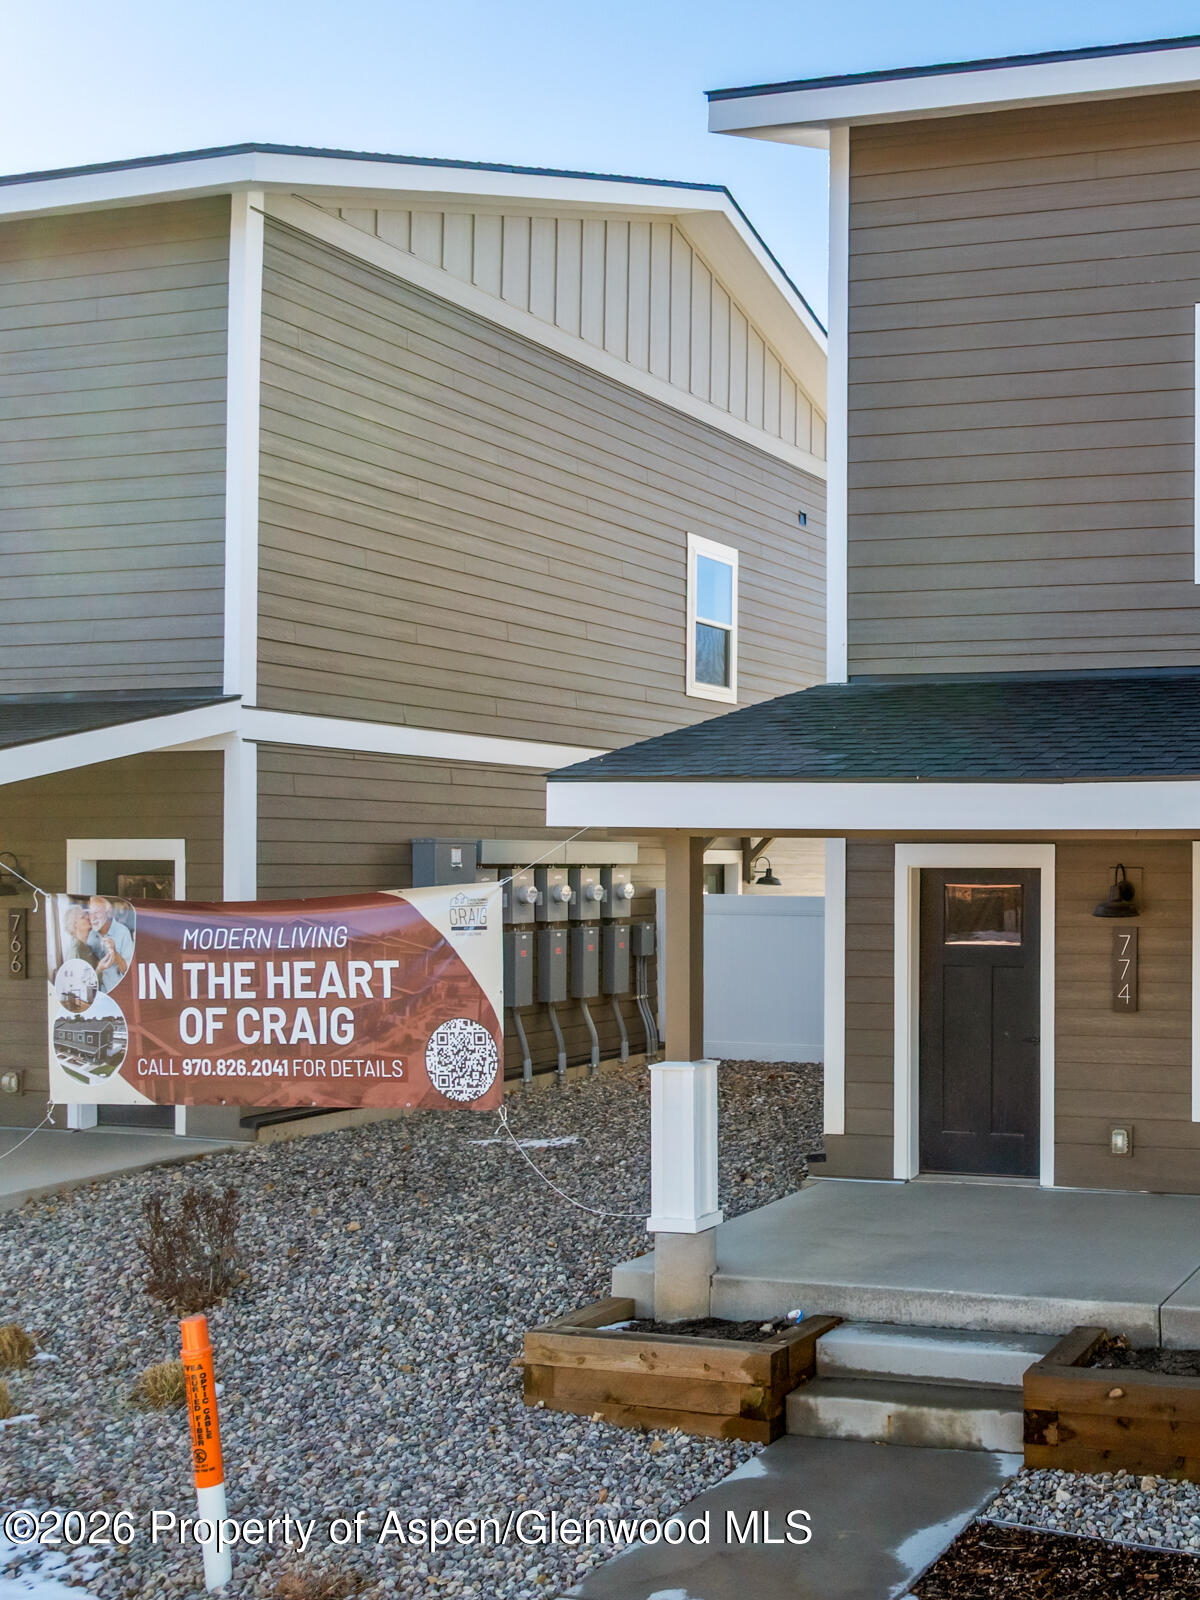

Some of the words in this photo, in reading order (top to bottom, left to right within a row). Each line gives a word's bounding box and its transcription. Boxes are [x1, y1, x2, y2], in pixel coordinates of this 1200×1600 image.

[449, 907, 487, 925] CRAIG
[9, 914, 22, 973] 766
[182, 926, 273, 950] MODERN
[277, 926, 348, 949] LIVING
[138, 962, 173, 1000] IN
[181, 961, 257, 1000] THE
[267, 959, 399, 999] HEART
[1117, 934, 1131, 1005] 774
[179, 1007, 226, 1045] OF
[236, 1007, 355, 1045] CRAIG
[137, 1059, 179, 1077] CALL
[182, 1058, 289, 1077] 970.826.2041
[292, 1059, 327, 1077] FOR
[330, 1058, 403, 1078] DETAILS
[200, 1373, 209, 1404] OPTIC
[204, 1408, 212, 1439] CABLE
